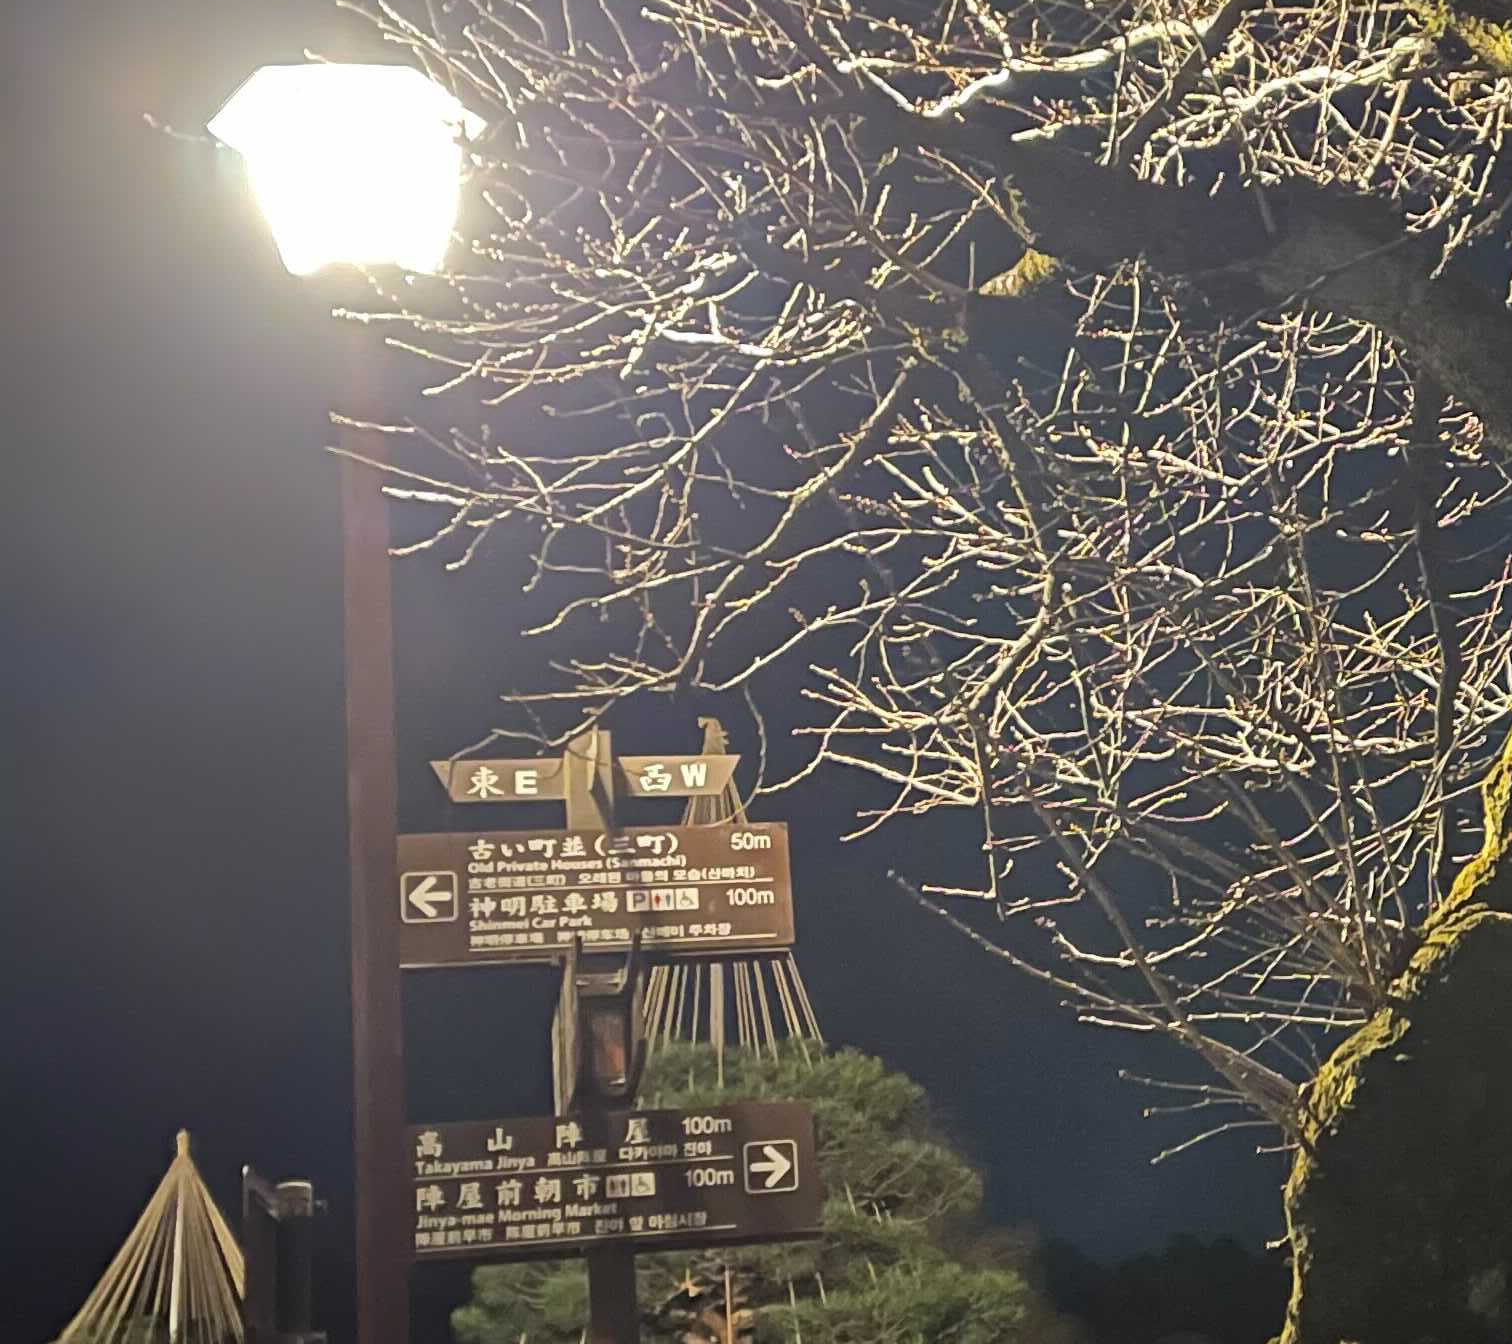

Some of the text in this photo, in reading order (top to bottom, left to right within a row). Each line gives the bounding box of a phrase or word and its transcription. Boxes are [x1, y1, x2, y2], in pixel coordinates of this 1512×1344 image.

[467, 766, 538, 798] 東 E
[640, 763, 707, 792] 西 W
[731, 832, 771, 850] 50m
[468, 855, 686, 874] Old Private Houses (Sanmachi)
[469, 891, 618, 918] 神明駐車場
[726, 888, 774, 906] 100m
[469, 915, 592, 932] Shinmei Car Park
[682, 1116, 732, 1135] 100m
[415, 1155, 535, 1175] Takayama Jinya
[416, 1169, 734, 1211] 陣屋前朝市 100m
[416, 1203, 618, 1231] Jinya-mae Morning Market
